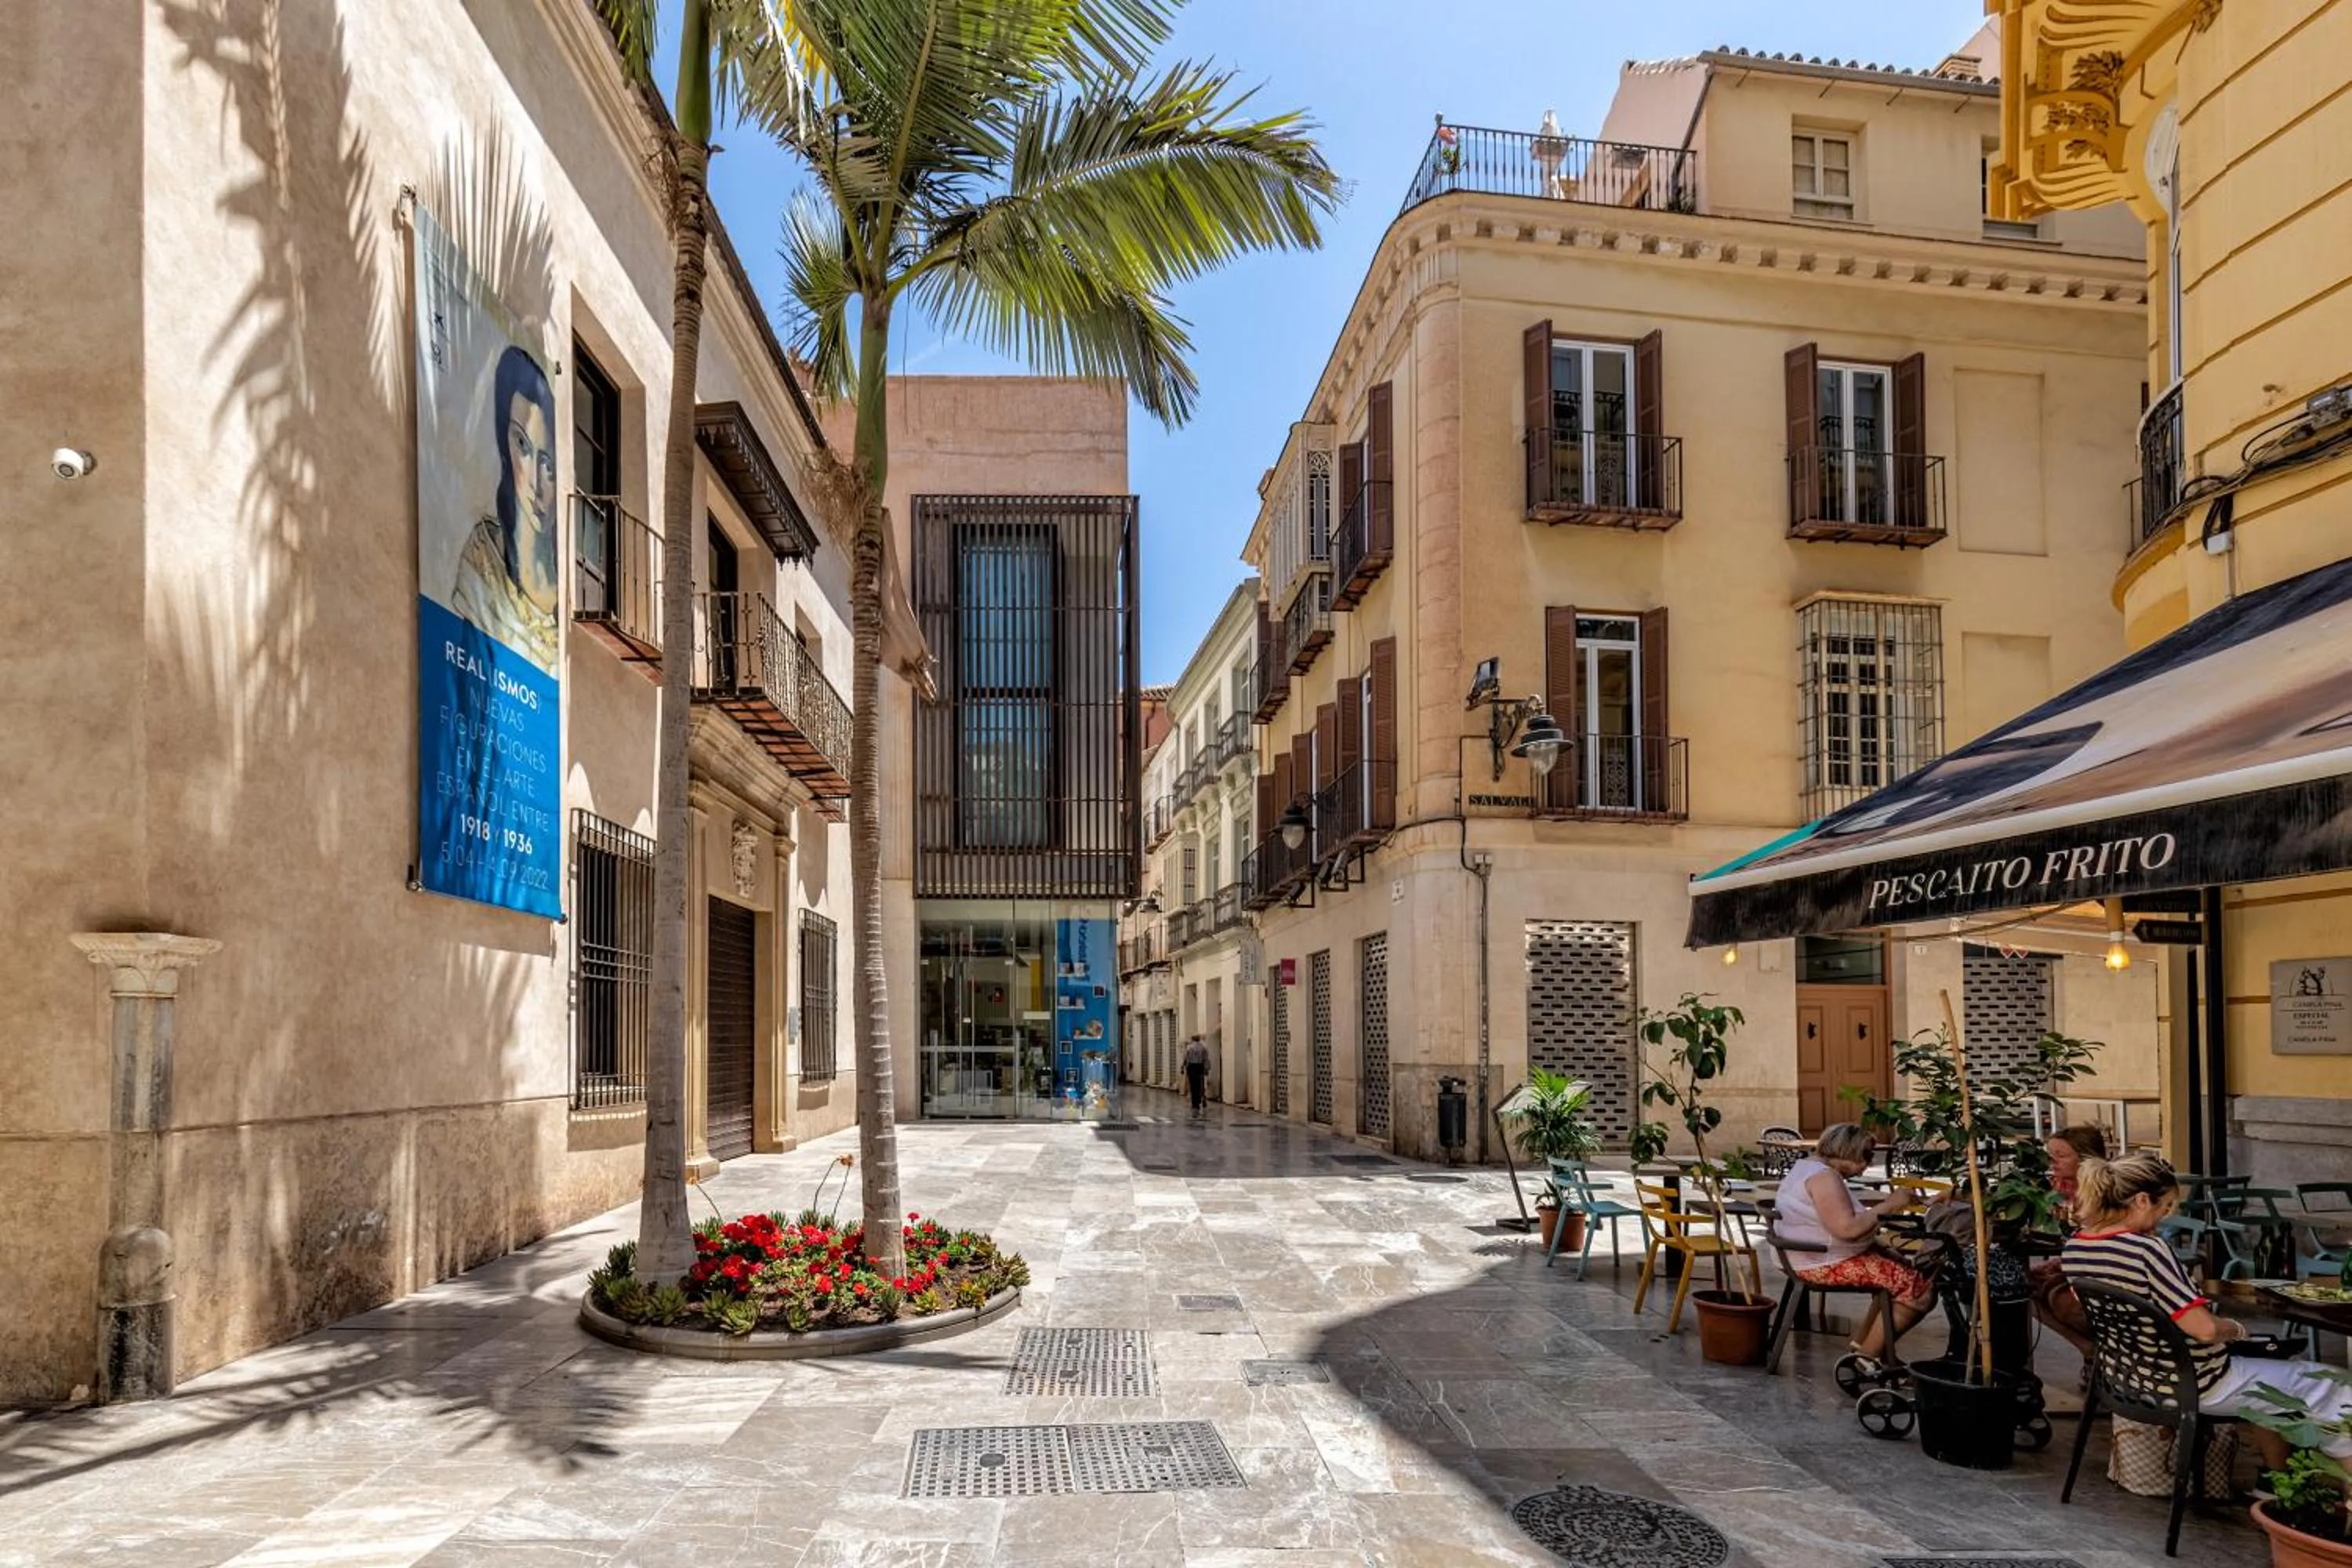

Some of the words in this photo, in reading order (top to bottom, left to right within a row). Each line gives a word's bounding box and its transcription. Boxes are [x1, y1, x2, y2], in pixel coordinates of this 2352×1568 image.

[470, 685, 524, 732] NUEVAS
[440, 704, 546, 774] FIGURACIONES
[456, 745, 476, 772] EN
[482, 757, 500, 782] EL
[504, 768, 535, 798] ARTE
[437, 771, 506, 817] ESPAÑOL
[511, 800, 549, 833] ENTRE
[460, 812, 491, 842] 1918
[503, 827, 533, 856] 1936
[1868, 856, 2032, 909] PESCAITO
[2039, 832, 2176, 886] FRITO
